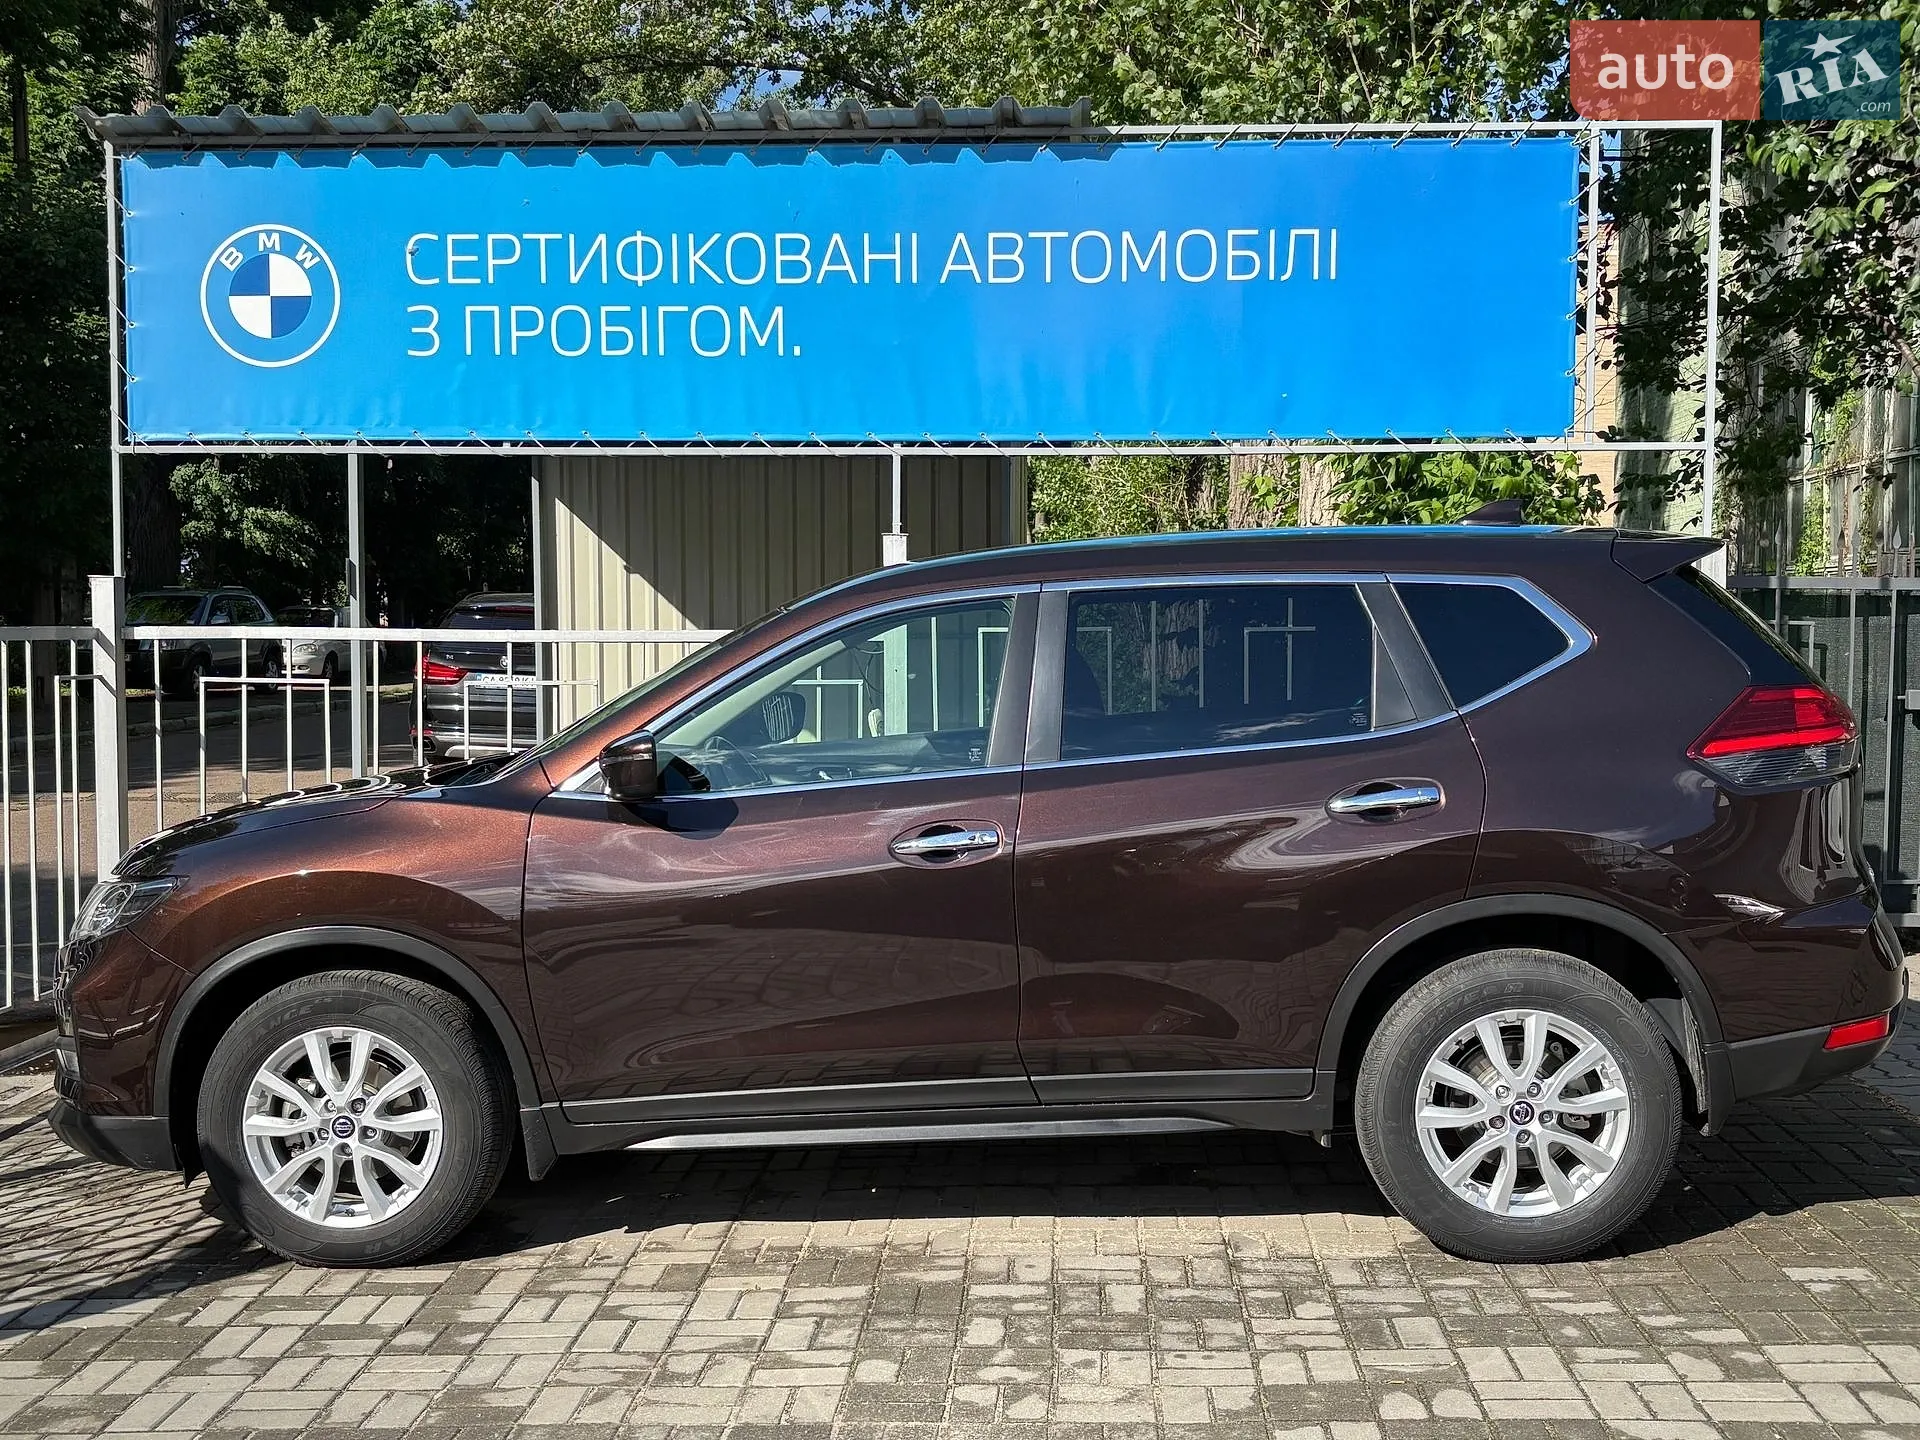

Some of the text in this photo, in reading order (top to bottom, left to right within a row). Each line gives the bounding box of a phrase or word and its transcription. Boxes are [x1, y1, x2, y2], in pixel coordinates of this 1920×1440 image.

[219, 232, 322, 272] BMW
[405, 228, 1338, 286] СЕРТИФІКОВАНІ АВТОМОБІЛІ
[465, 304, 801, 357] ПРОБІГОМ.
